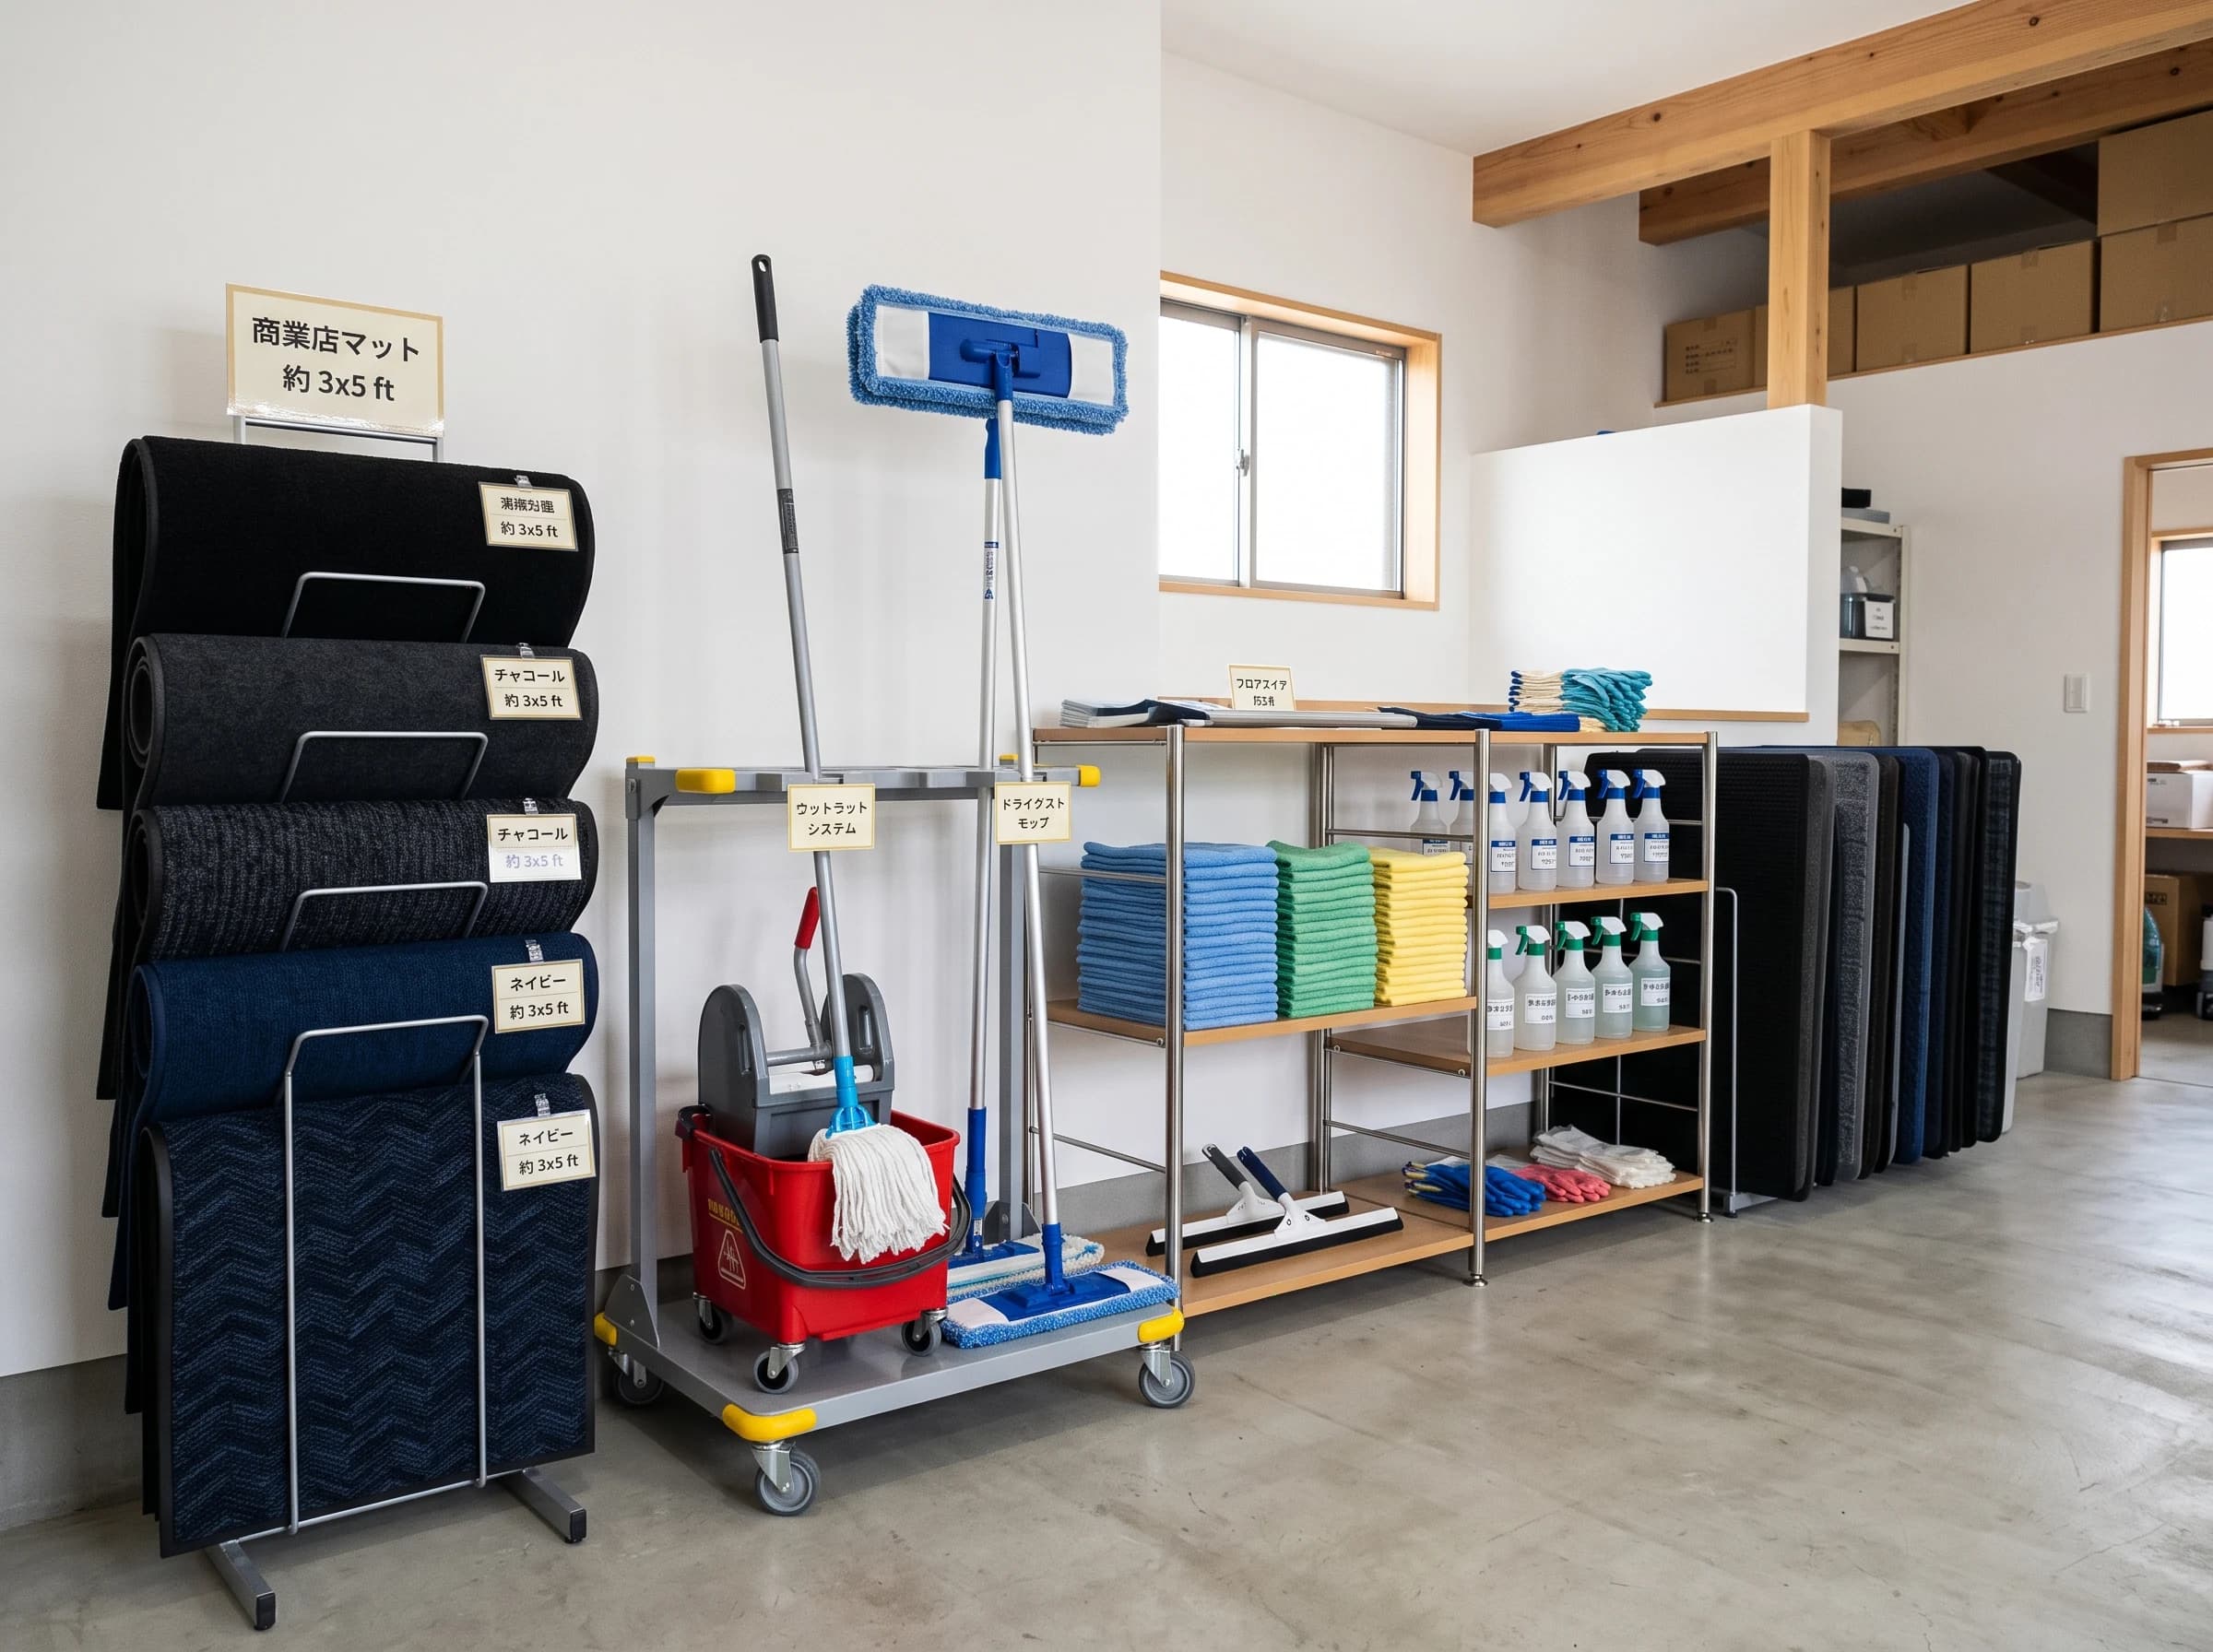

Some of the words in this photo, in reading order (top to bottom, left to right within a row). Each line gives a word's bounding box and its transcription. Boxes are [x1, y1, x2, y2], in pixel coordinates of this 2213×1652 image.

[252, 316, 420, 362] 商業店マット
[282, 364, 311, 394] 約
[318, 371, 366, 397] 3x5
[373, 376, 395, 401] ft
[500, 521, 515, 536] 約
[518, 524, 543, 537] 3x5
[546, 525, 559, 537] ft
[494, 669, 565, 682] チャコール
[504, 694, 519, 707] 約
[523, 695, 548, 707] 3x5
[550, 695, 563, 707] ft
[498, 828, 568, 841] チャコール
[809, 822, 857, 835] システム
[505, 855, 520, 868] 約
[524, 856, 549, 867] 3x5
[551, 855, 563, 867] ft
[510, 974, 566, 991] ネイビー
[510, 1005, 524, 1020] 約
[528, 1003, 553, 1017] 3x5
[557, 1001, 569, 1014] ft
[519, 1128, 574, 1146] ネイビー
[519, 1161, 534, 1175] 約
[538, 1156, 563, 1172] 3x5
[566, 1154, 579, 1167] ft
